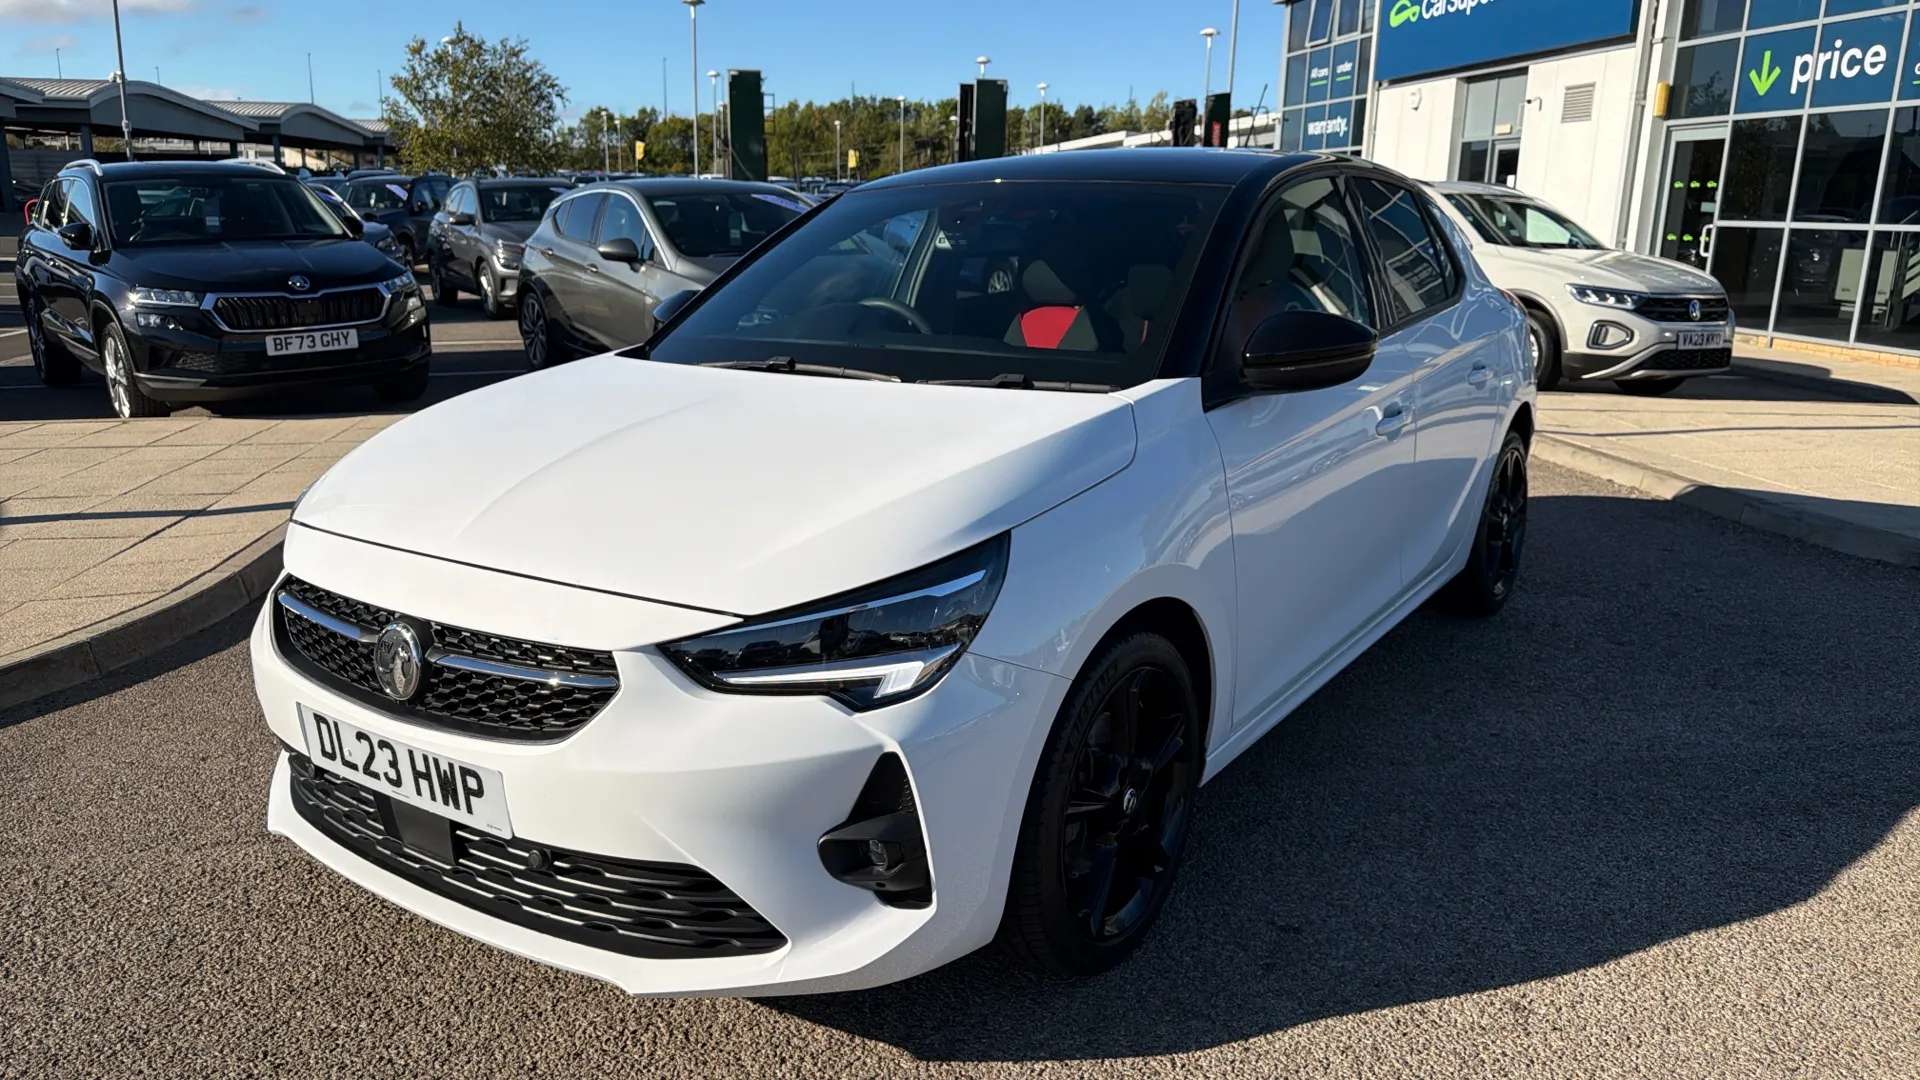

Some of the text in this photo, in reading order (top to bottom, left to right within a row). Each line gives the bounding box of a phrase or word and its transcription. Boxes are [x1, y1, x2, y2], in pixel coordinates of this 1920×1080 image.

[1336, 61, 1353, 74] under
[1790, 39, 1887, 94] price
[272, 331, 350, 352] BF73 GHY
[313, 712, 485, 815] DL23 HWP
